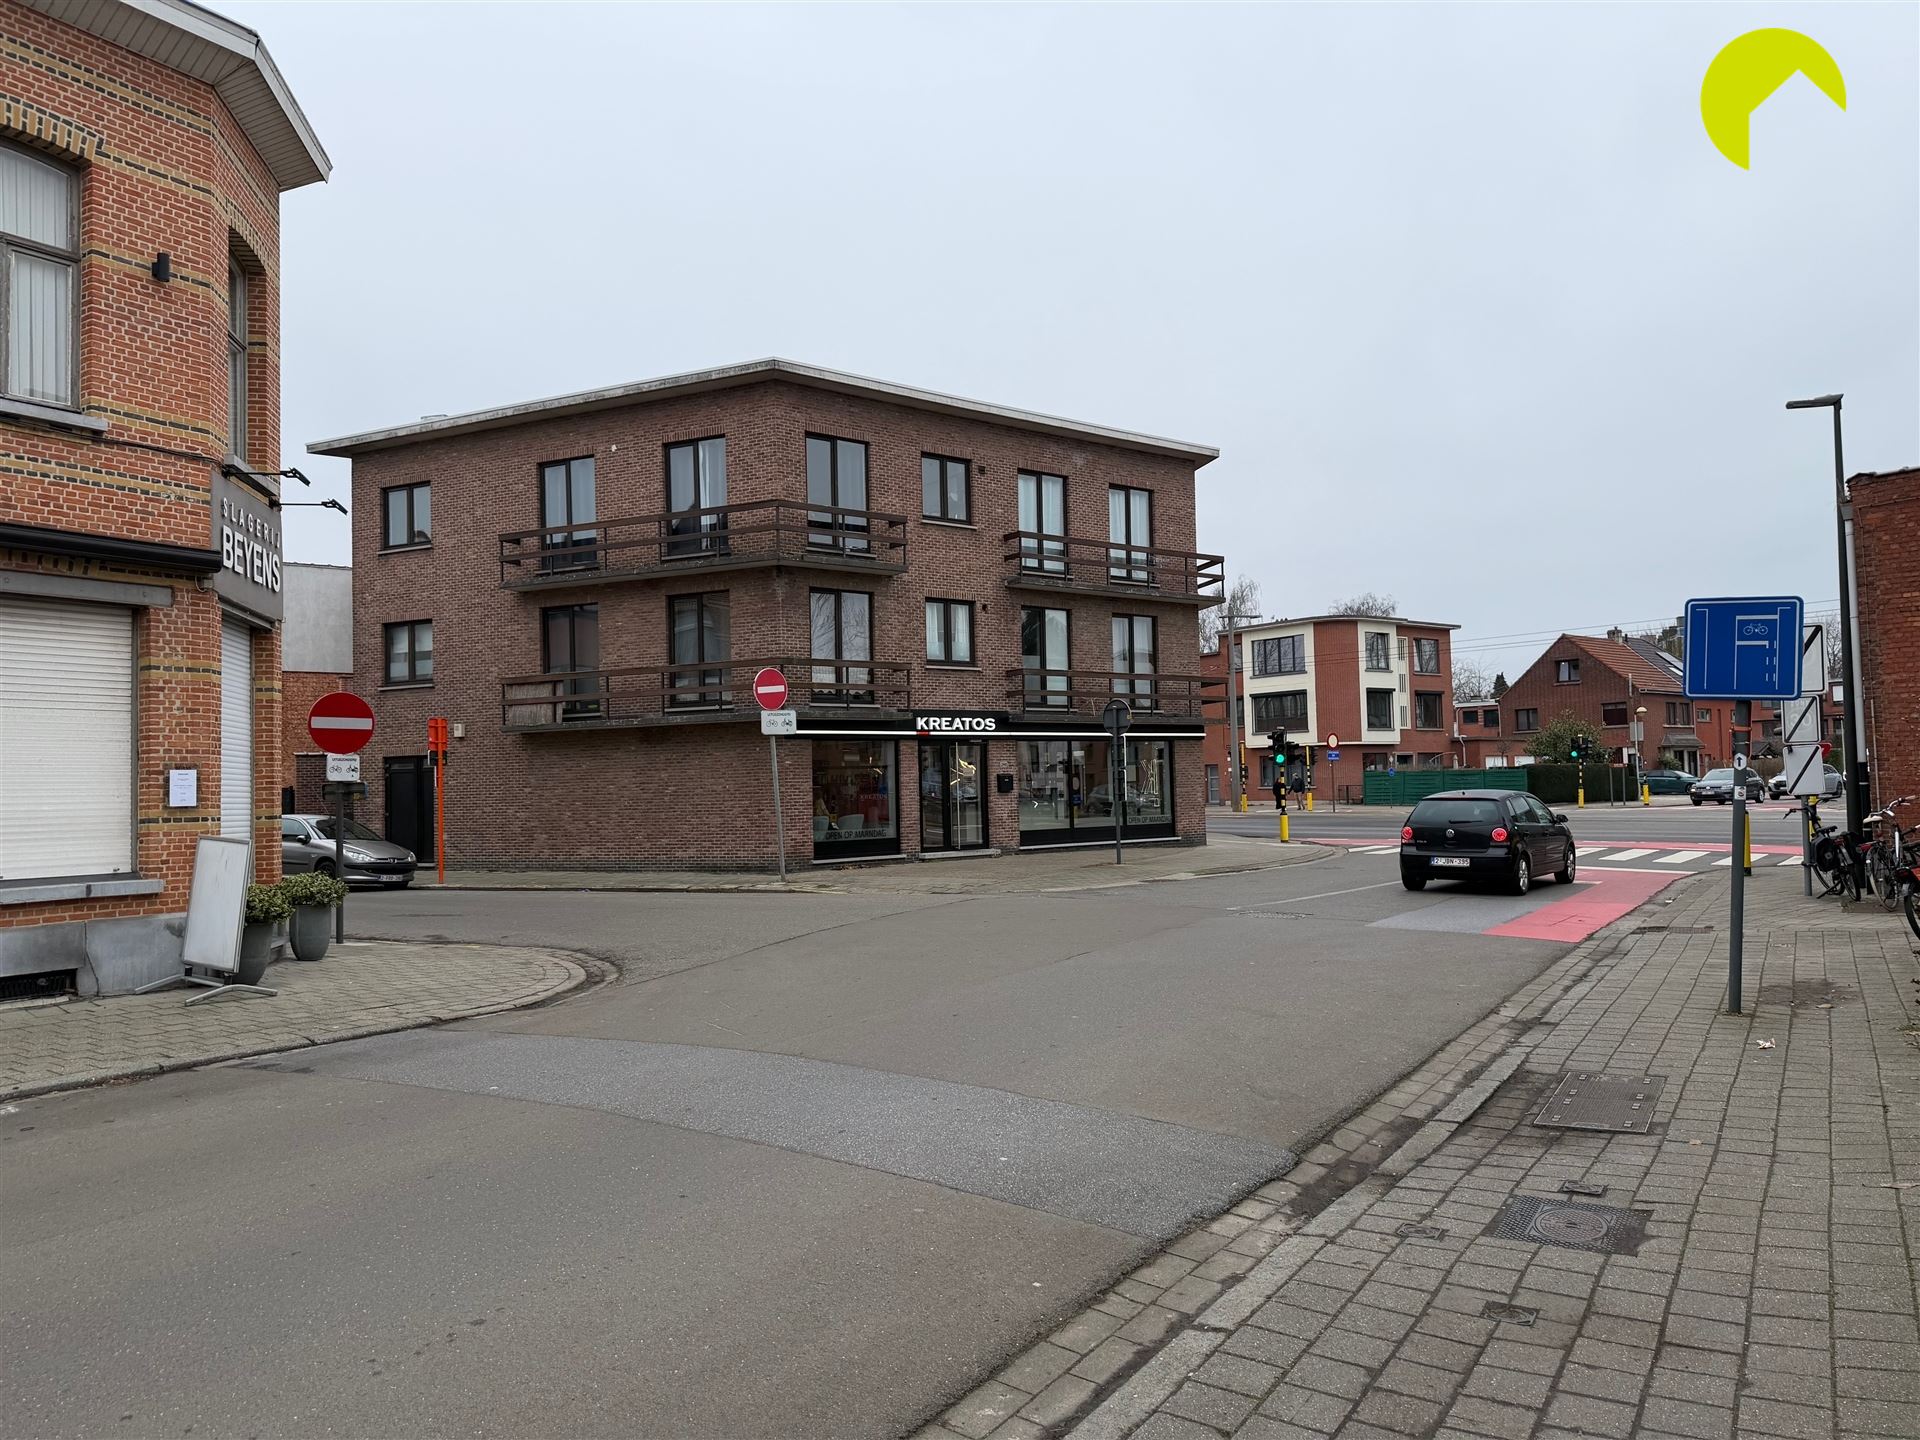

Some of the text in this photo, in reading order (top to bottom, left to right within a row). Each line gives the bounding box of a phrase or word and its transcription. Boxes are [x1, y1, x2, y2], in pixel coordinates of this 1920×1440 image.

[222, 497, 281, 549] SLAGERIJ
[222, 525, 281, 593] BEYENS
[916, 717, 996, 731] KREATOS
[825, 831, 843, 840] OPEN
[844, 830, 853, 839] OP
